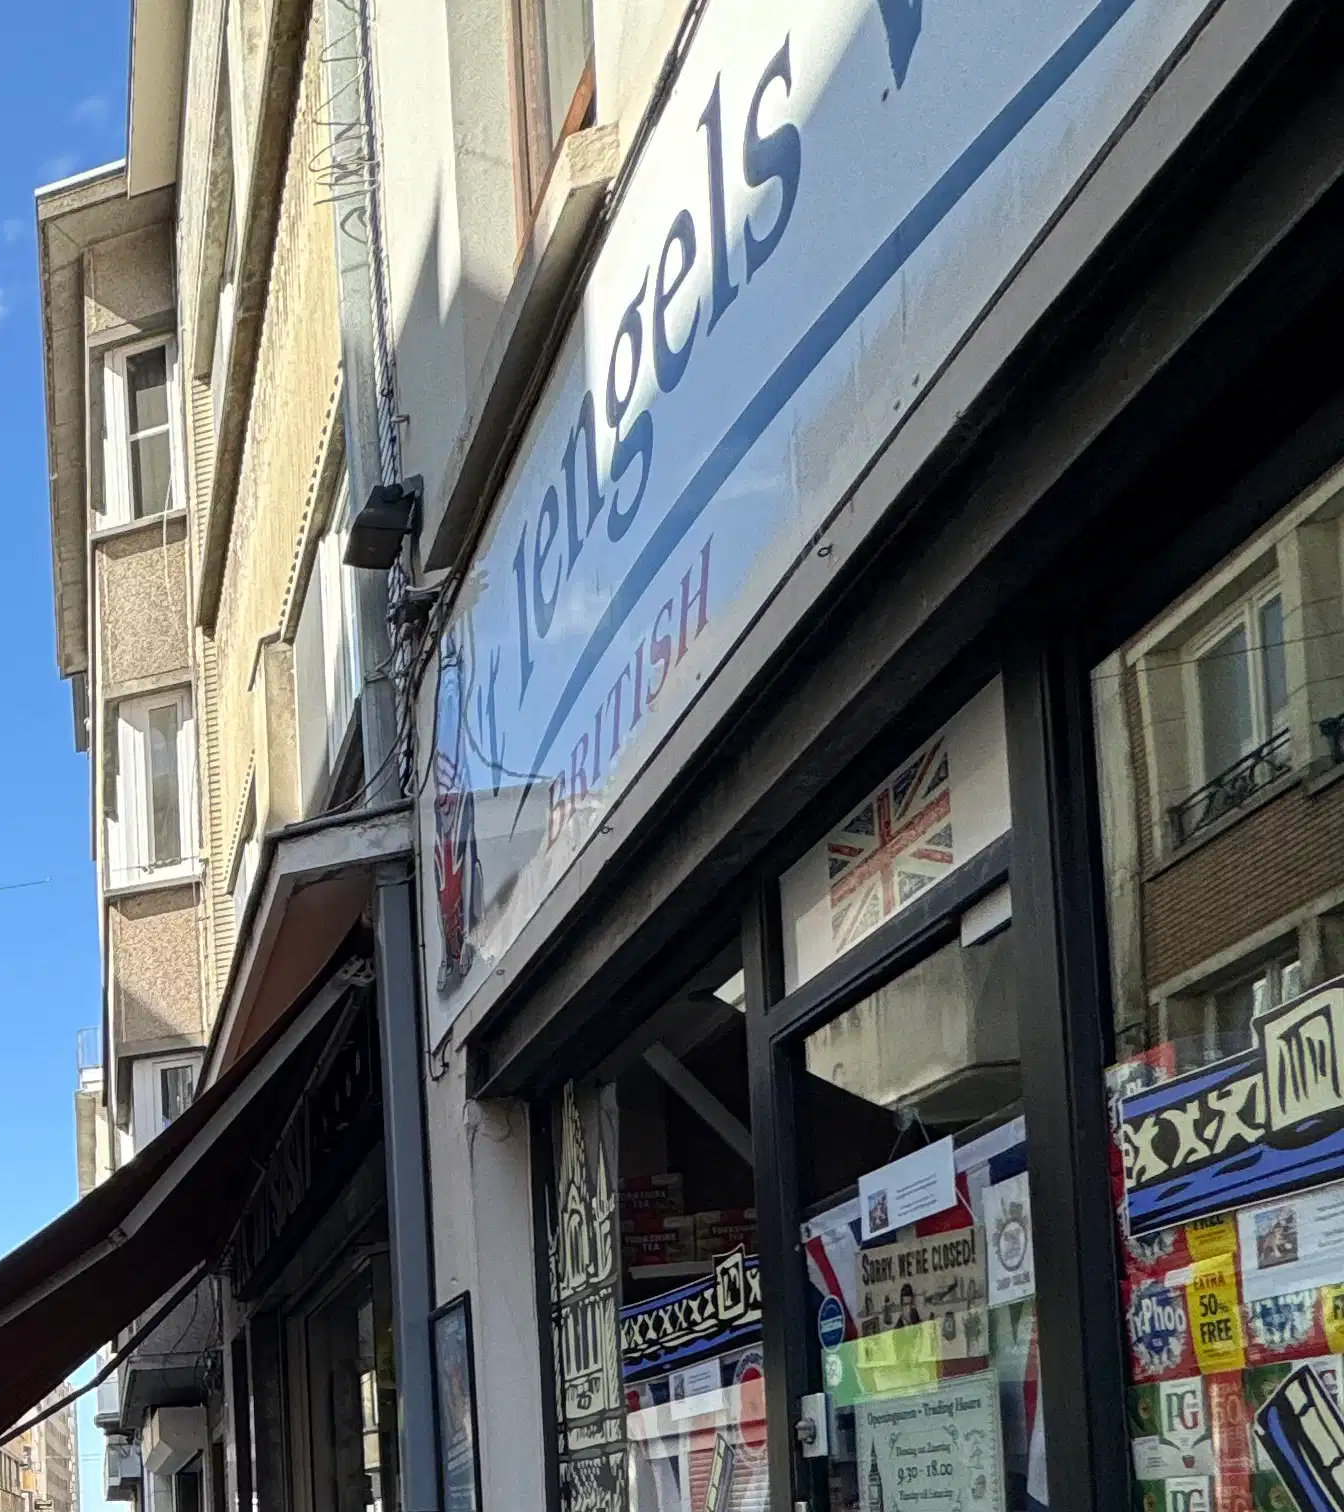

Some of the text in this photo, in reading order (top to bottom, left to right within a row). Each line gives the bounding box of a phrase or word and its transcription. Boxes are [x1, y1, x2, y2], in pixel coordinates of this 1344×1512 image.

[546, 533, 714, 852] BRITISH
[931, 1229, 977, 1271] CLOSED!
[1199, 1317, 1233, 1345] FREE
[1166, 1389, 1200, 1433] PG
